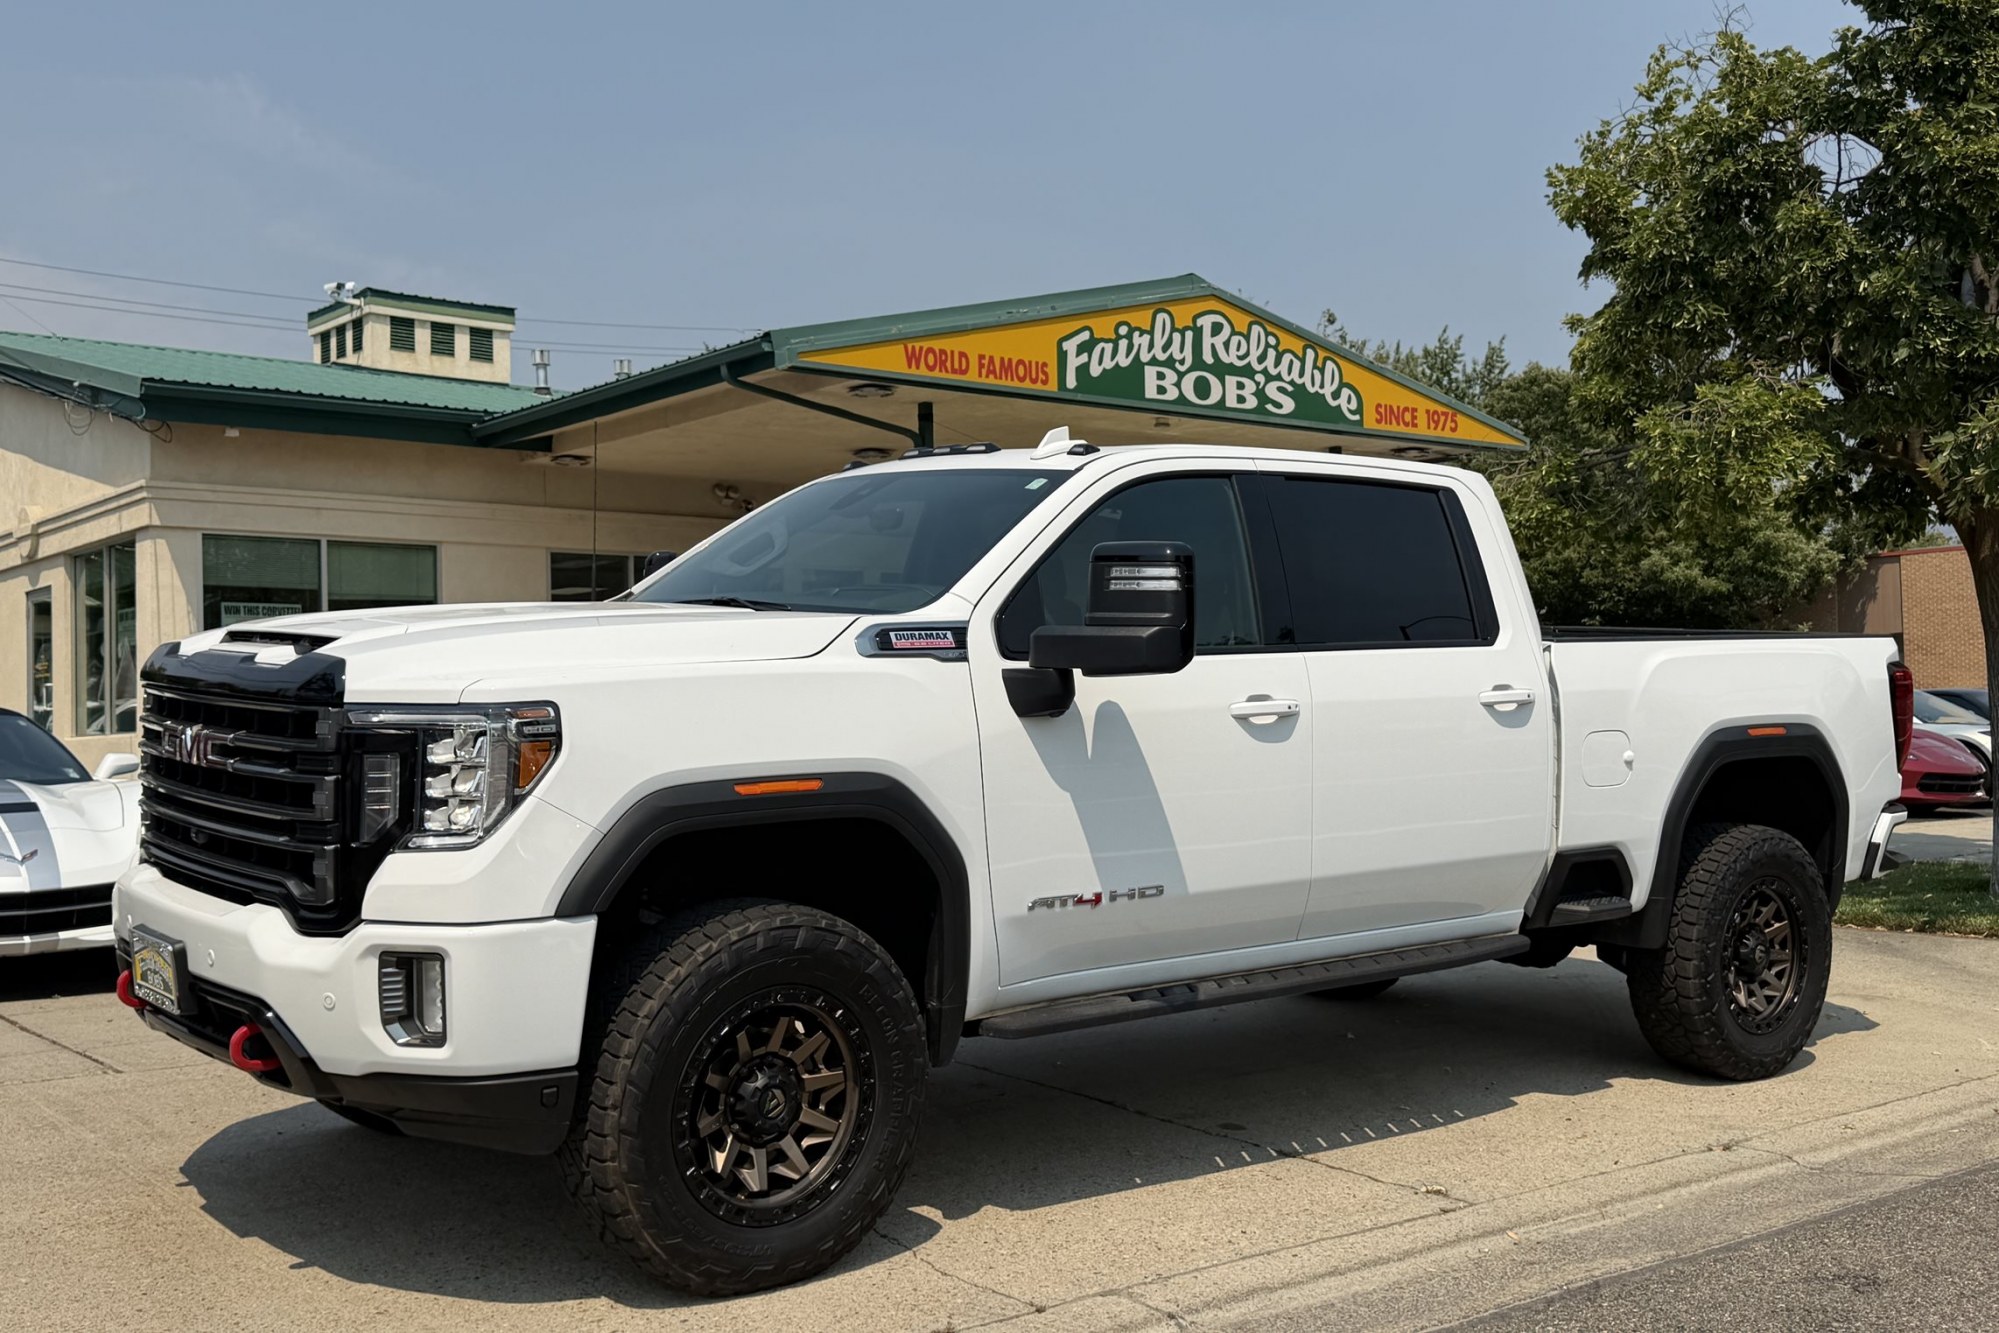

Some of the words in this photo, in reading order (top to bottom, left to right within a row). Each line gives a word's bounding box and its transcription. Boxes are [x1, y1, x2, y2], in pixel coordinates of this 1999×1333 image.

[903, 343, 970, 376] WORLD
[977, 353, 1050, 386] FAMOUS
[1062, 312, 1193, 389] Fairly
[1196, 314, 1361, 421] Reliable
[1144, 365, 1296, 415] BOB'S
[1375, 402, 1418, 428] SINCE
[1425, 409, 1459, 433] 1975
[223, 605, 241, 616] WIN
[242, 605, 260, 616] THIS
[894, 632, 949, 641] DURAMAX
[162, 723, 234, 772] GMC
[1027, 892, 1103, 913] AT4
[1109, 884, 1165, 903] HD
